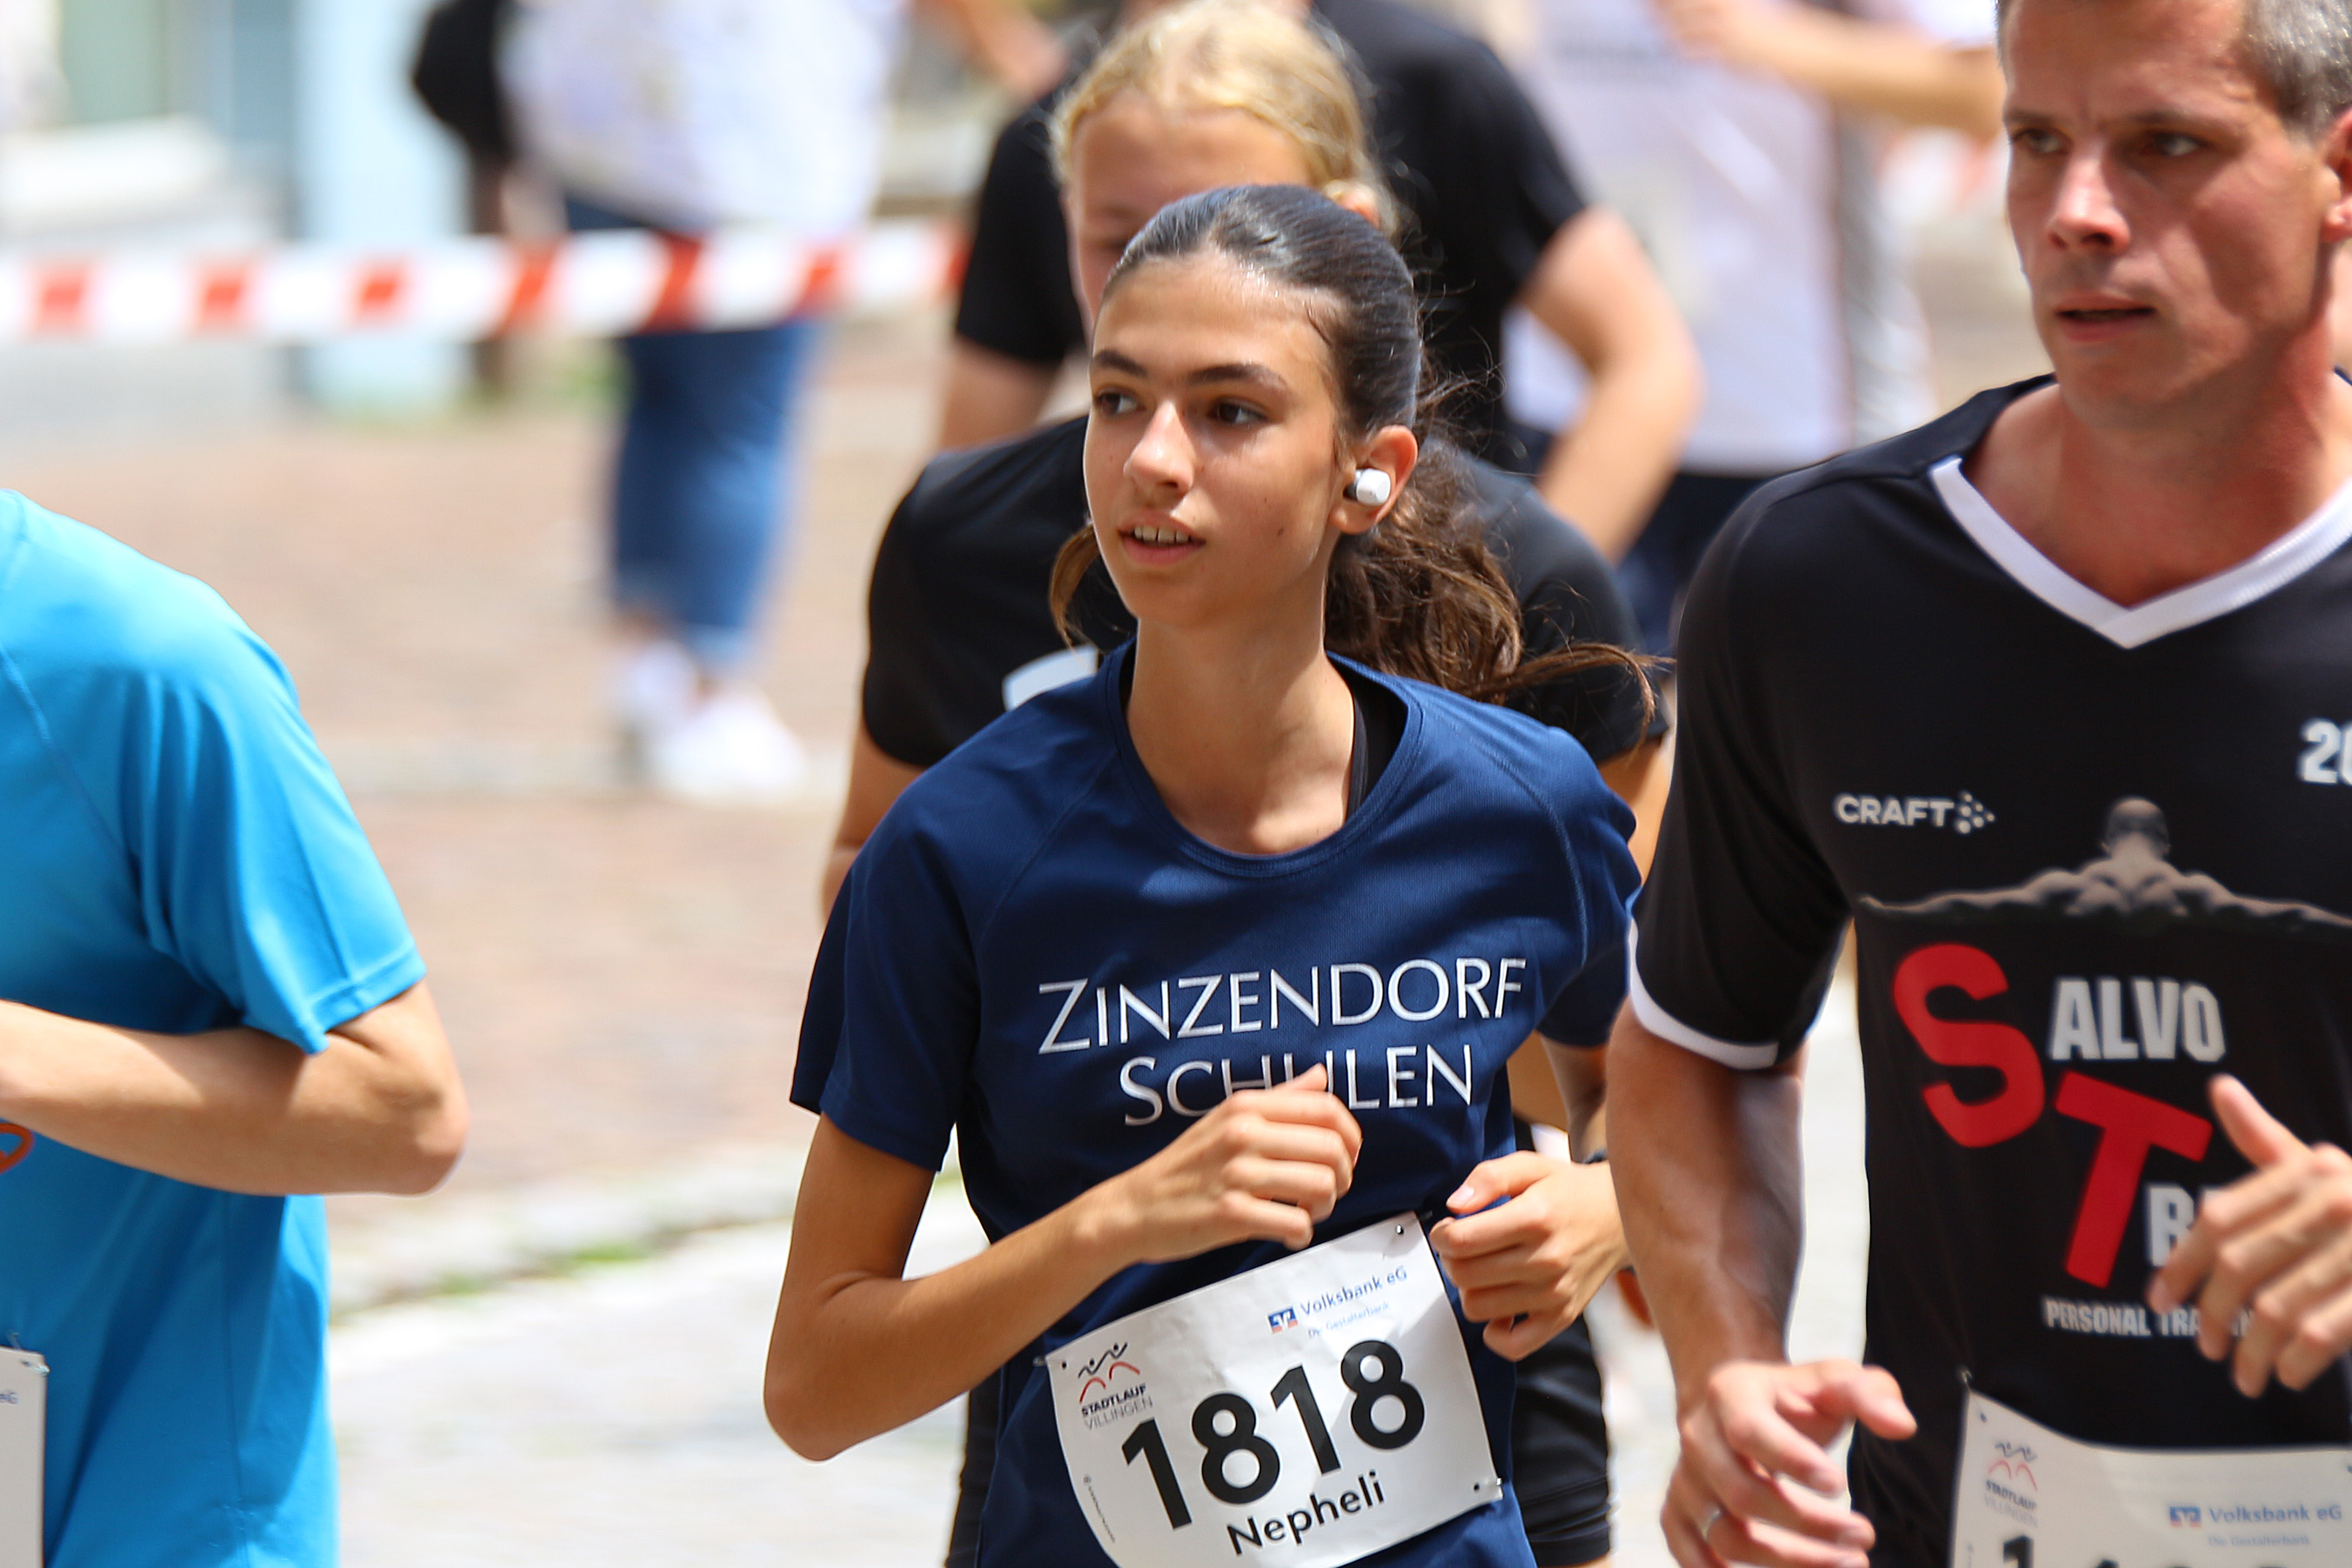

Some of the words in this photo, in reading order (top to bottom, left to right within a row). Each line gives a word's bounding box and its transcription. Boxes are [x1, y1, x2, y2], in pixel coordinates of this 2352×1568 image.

[1834, 794, 1956, 827] CRAFT
[1039, 957, 1527, 1054] ZINZENDORF
[1300, 1275, 1382, 1316] Volksbank
[1387, 1265, 1407, 1284] eG
[2043, 1298, 2152, 1336] PERSONAL
[1081, 1382, 1146, 1416] STADTLAUF
[1083, 1395, 1153, 1431] VILLINGEN
[1121, 1340, 1426, 1532] 1818
[1227, 1470, 1385, 1555] Nepheli
[1986, 1479, 2037, 1511] STADTLAUF
[2209, 1504, 2310, 1523] Volksbank
[2316, 1504, 2343, 1521] eG
